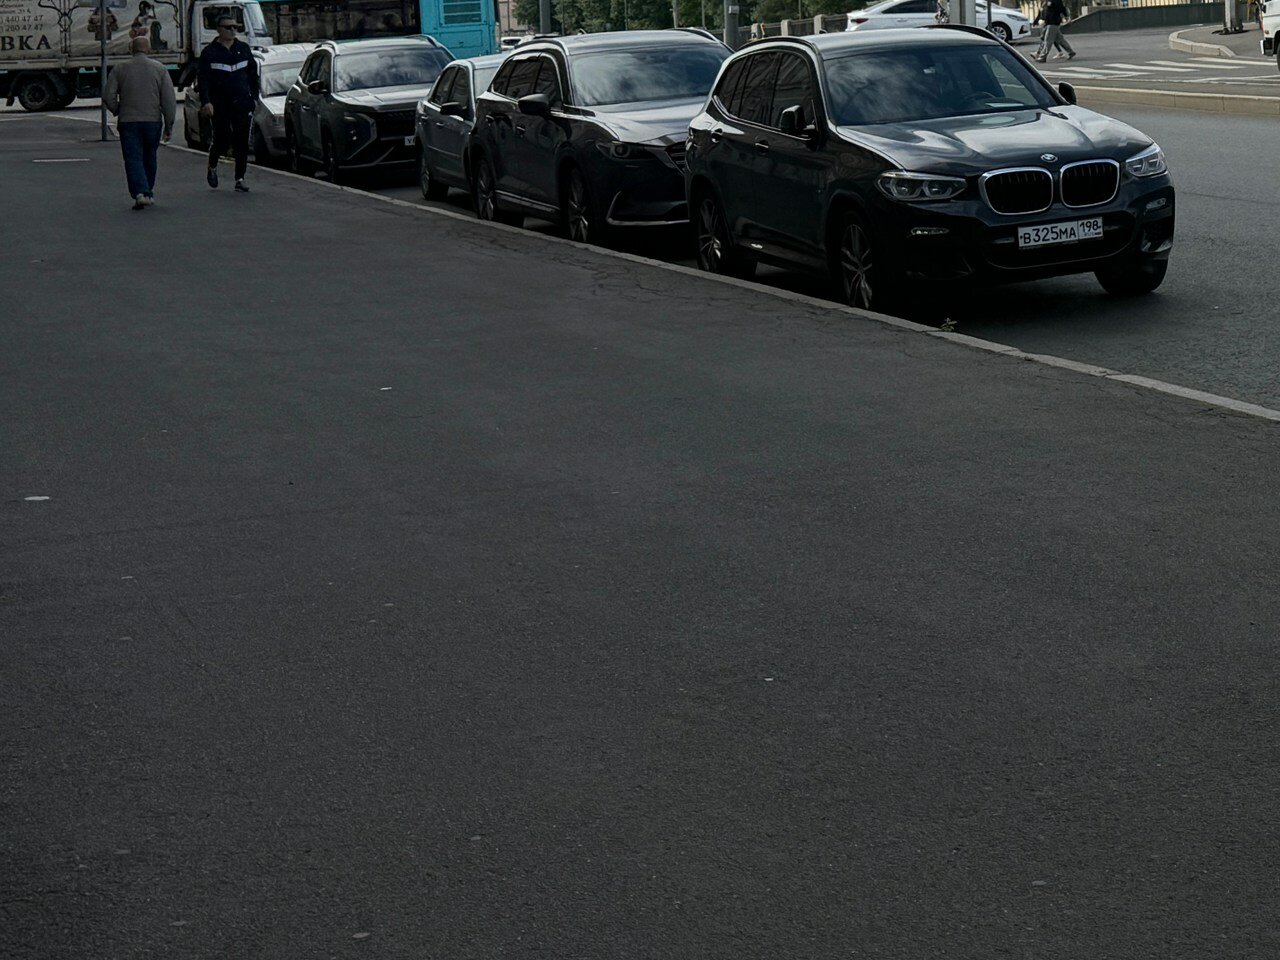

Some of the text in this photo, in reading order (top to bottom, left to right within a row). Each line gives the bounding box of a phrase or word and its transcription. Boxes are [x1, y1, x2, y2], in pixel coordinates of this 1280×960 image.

[0, 34, 52, 51] ВКА
[1023, 220, 1099, 244] В325МА 198
